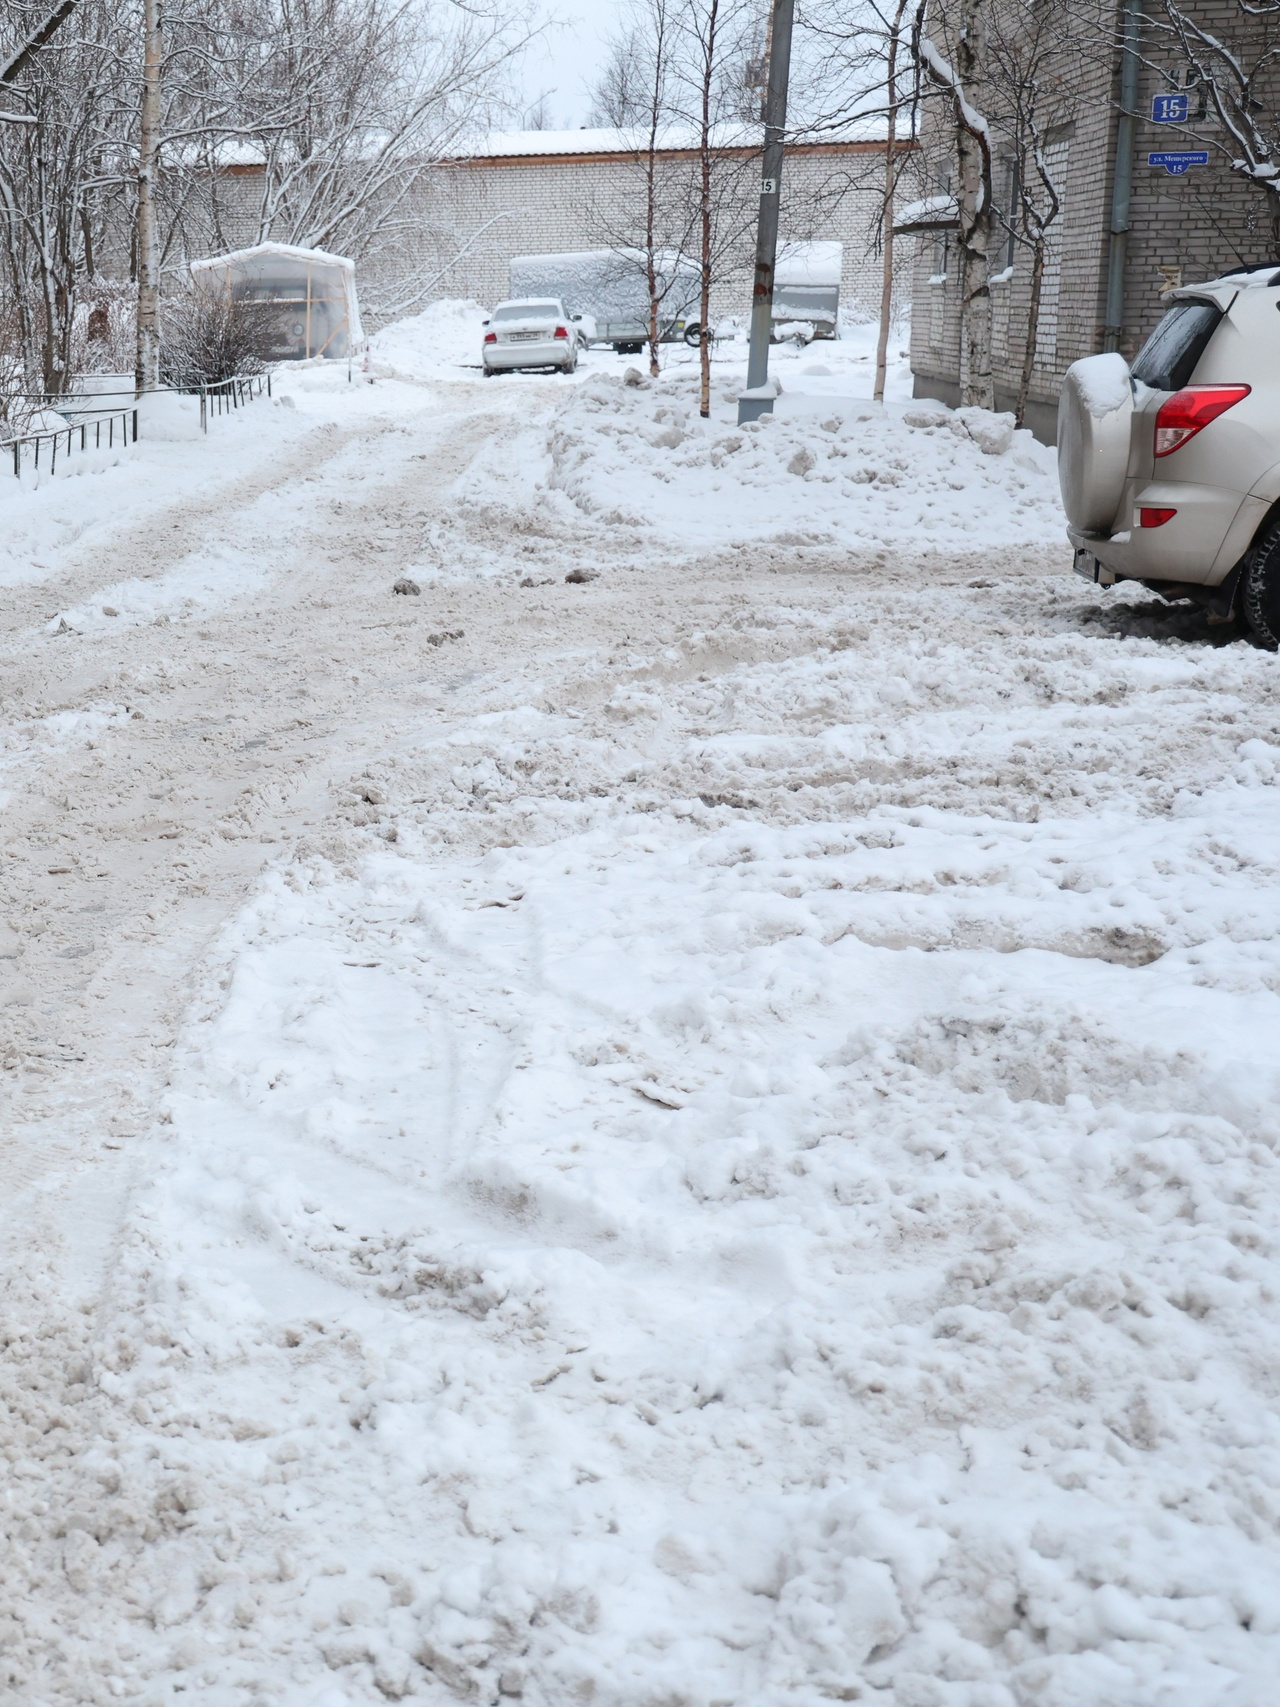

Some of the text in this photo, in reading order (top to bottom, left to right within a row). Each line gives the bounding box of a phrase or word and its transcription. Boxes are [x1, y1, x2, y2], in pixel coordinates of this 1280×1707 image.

[1160, 100, 1180, 118] 15
[1172, 164, 1183, 173] 15
[761, 181, 772, 192] 15
